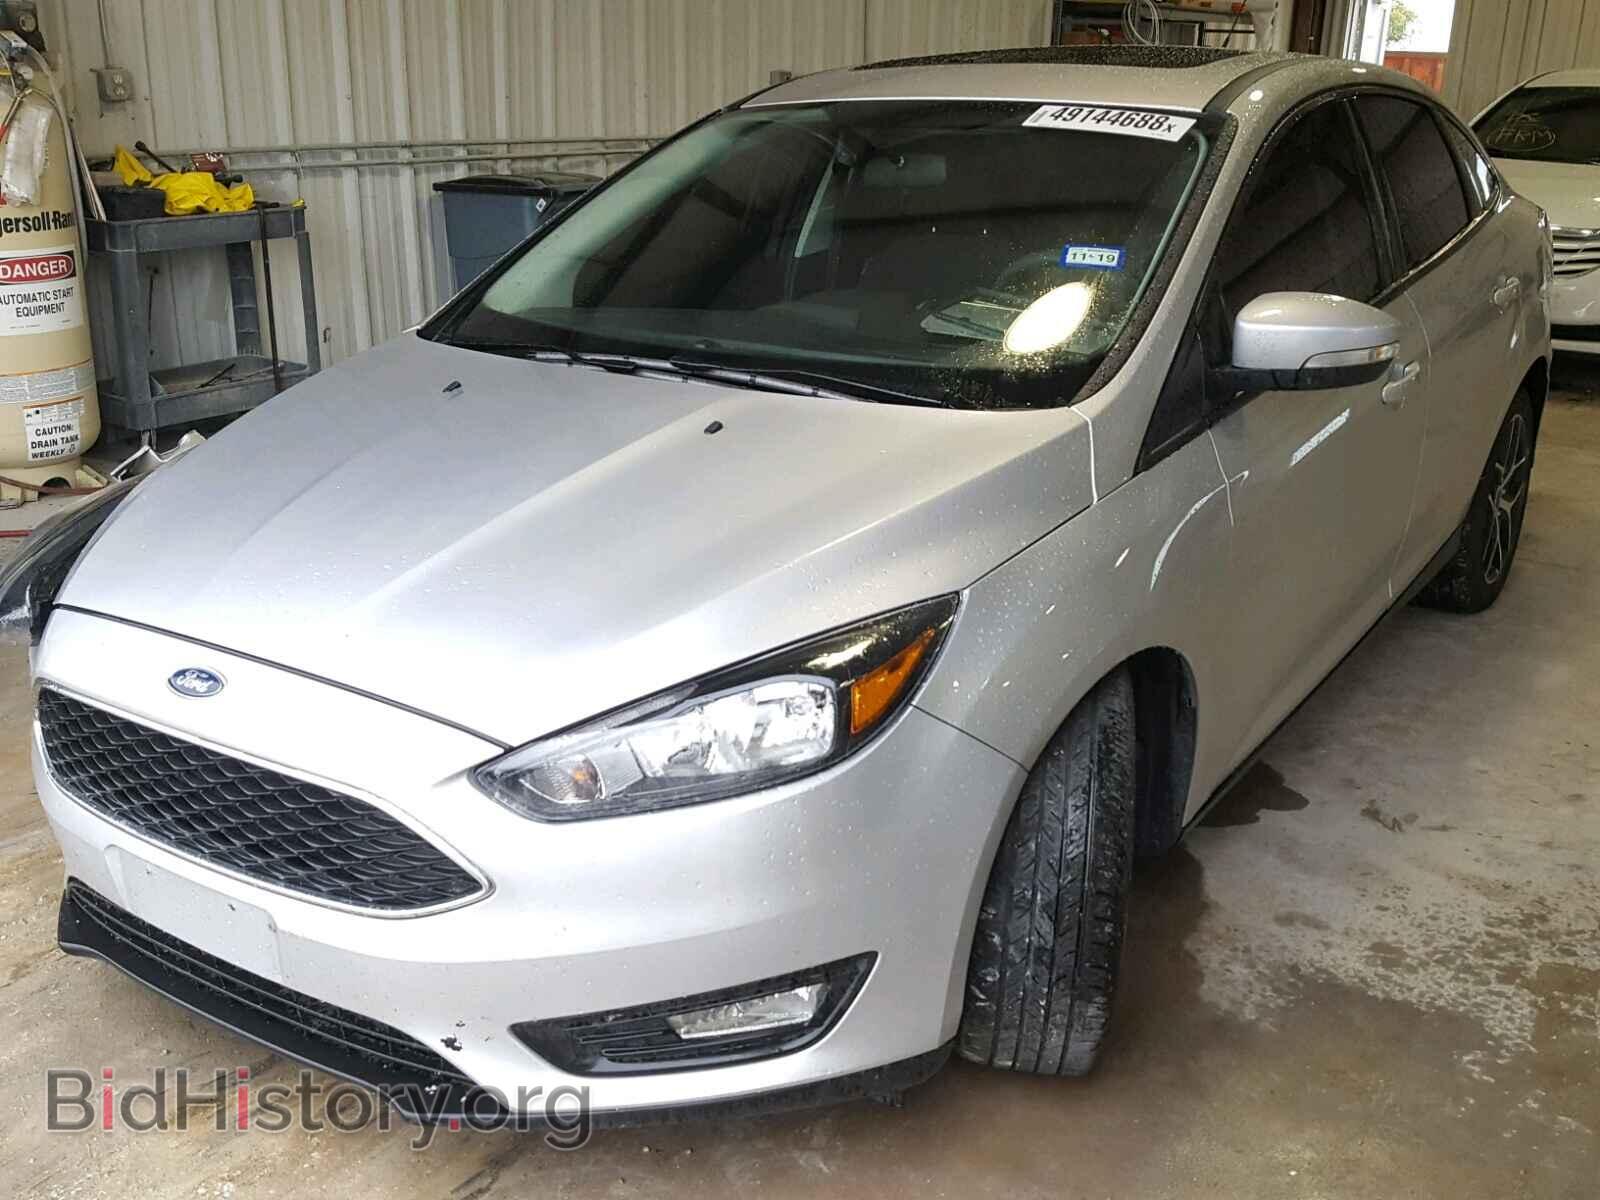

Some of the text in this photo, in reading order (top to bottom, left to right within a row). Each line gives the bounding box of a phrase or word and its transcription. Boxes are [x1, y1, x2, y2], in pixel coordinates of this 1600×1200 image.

[0, 259, 68, 279] DANGER
[53, 287, 74, 300] START
[16, 302, 65, 317] EQUIPMENT
[31, 434, 79, 449] DRAIN TANK
[32, 448, 65, 459] WEEKLY
